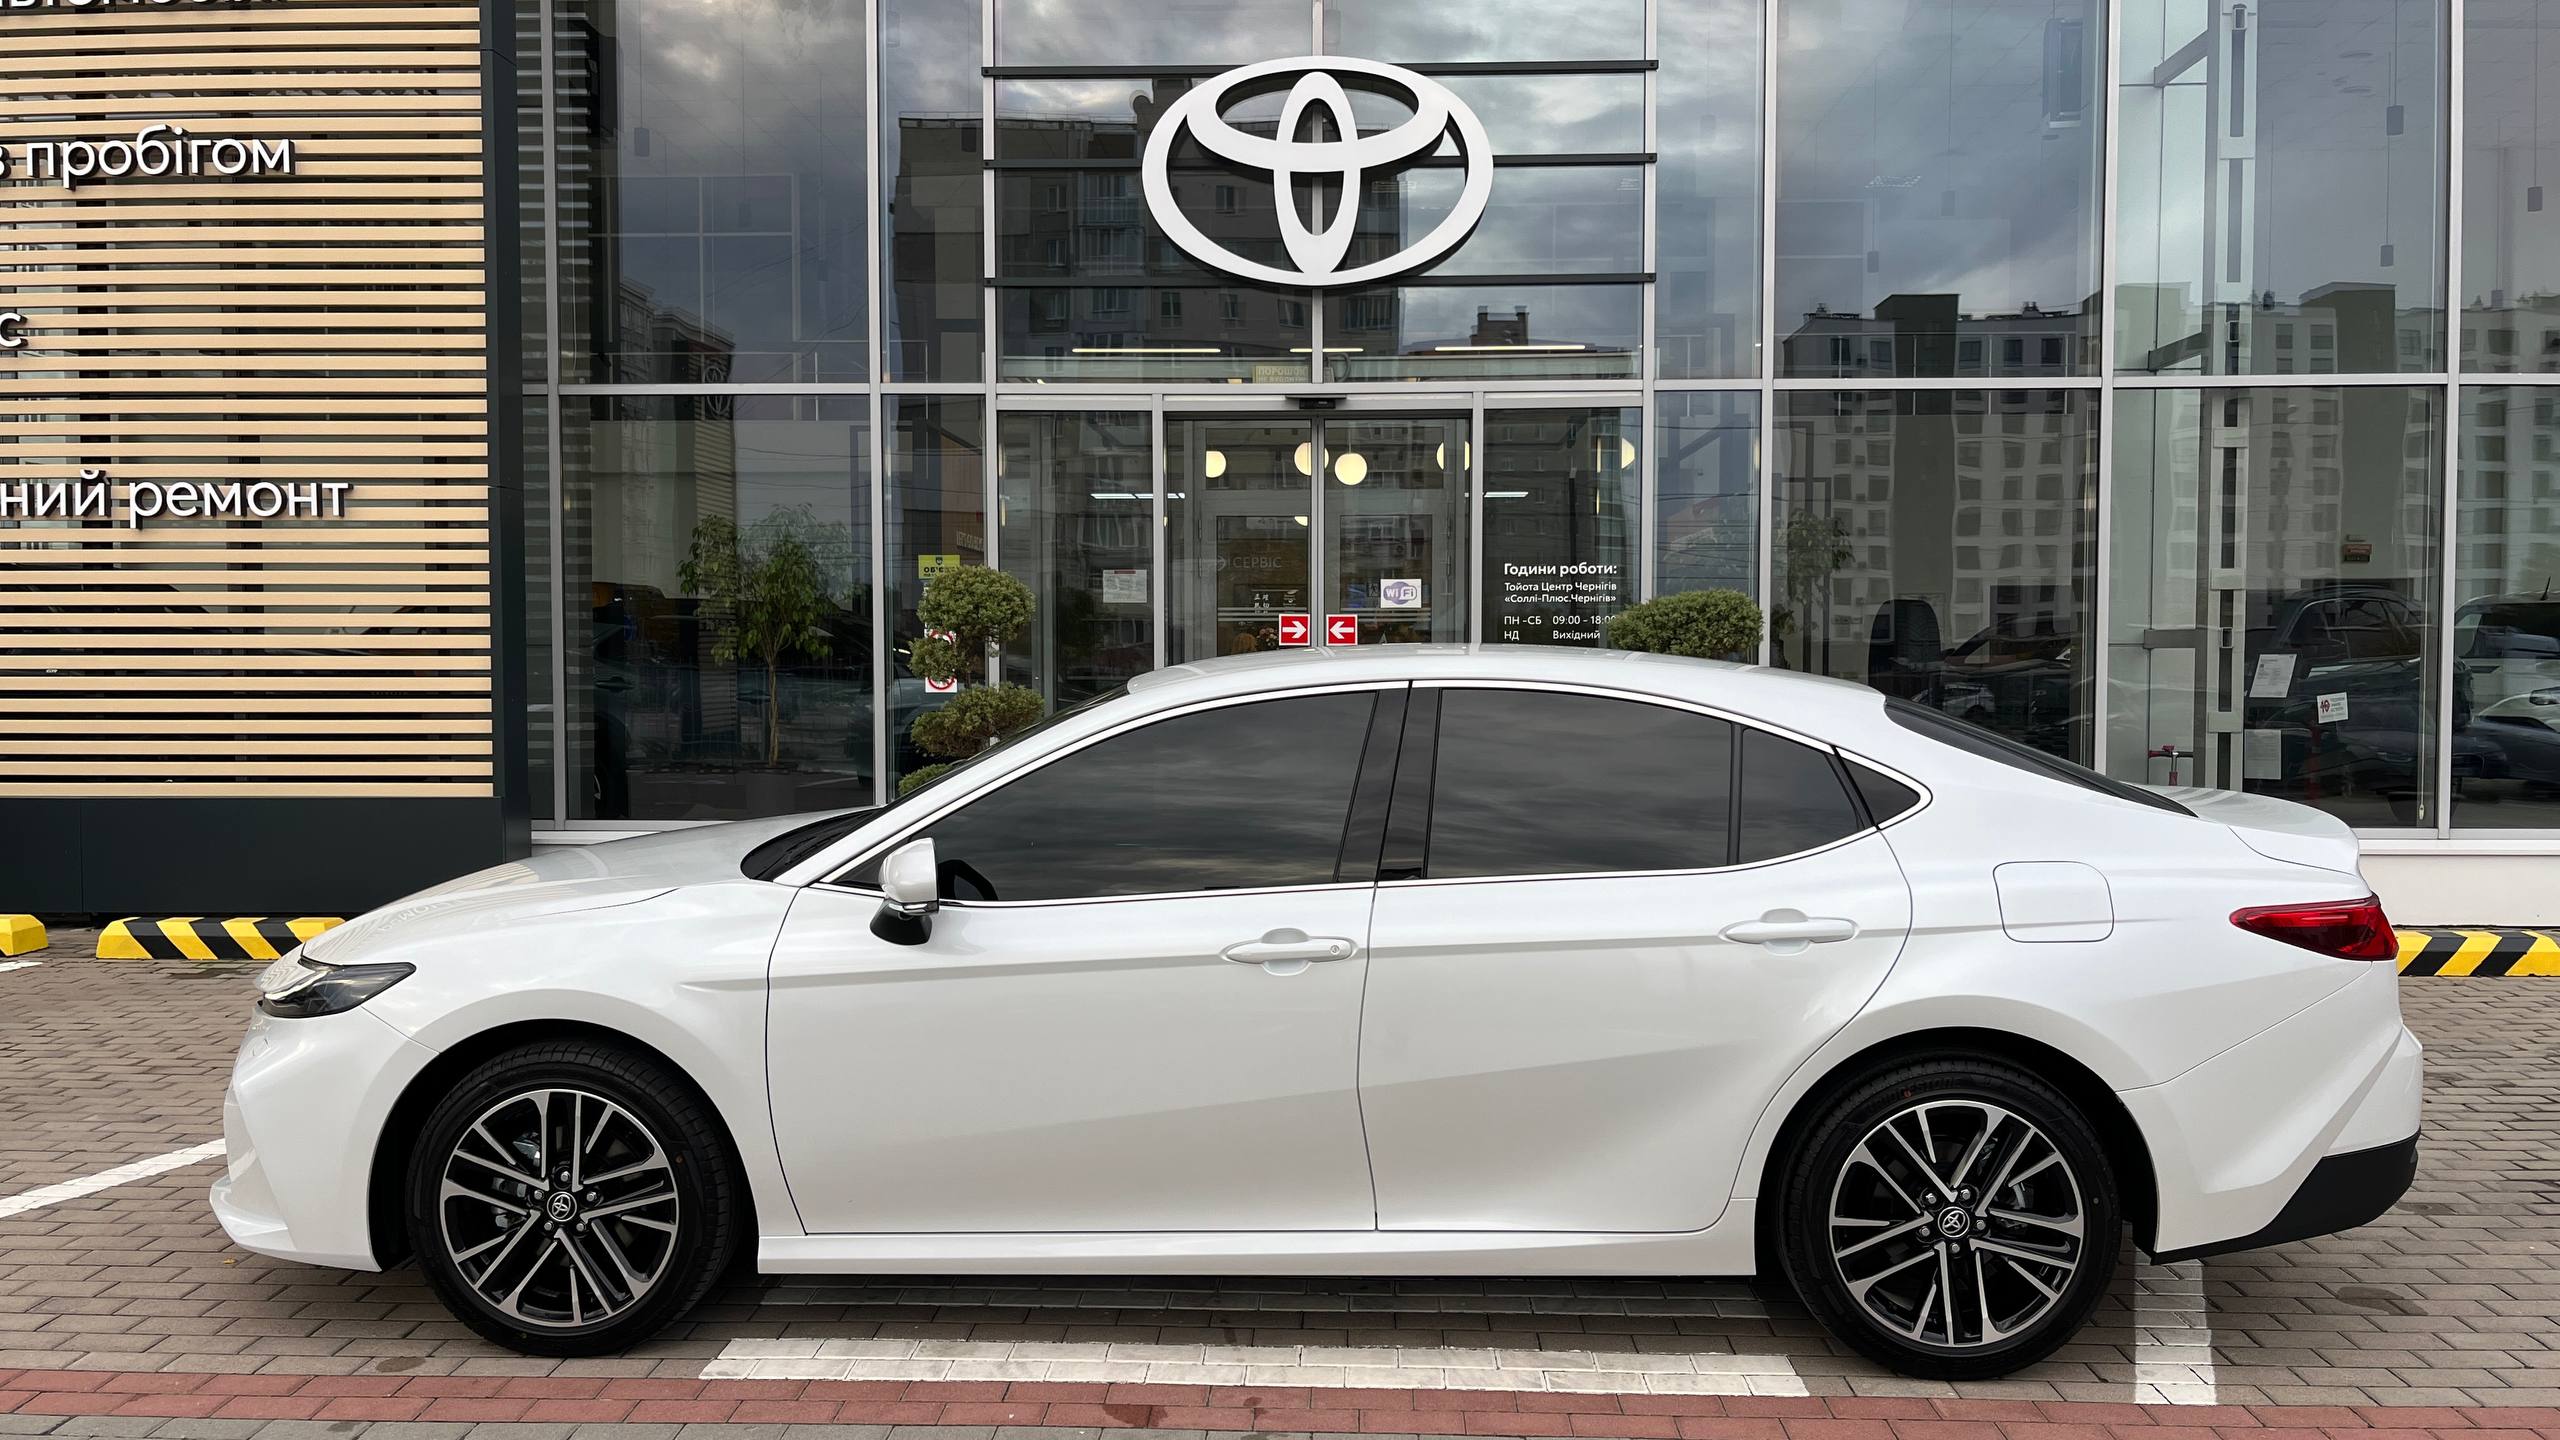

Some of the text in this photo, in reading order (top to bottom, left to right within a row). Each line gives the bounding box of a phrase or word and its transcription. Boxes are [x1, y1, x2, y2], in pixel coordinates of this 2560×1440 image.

[26, 123, 292, 189] пробігом
[129, 481, 350, 529] ремонт
[1504, 562, 1617, 577] Години роботи:
[1504, 582, 1617, 592] Тойота Центр Чернігів
[1504, 616, 1520, 625] ПН
[1552, 616, 1580, 625] 09:00
[1504, 630, 1600, 640] НД Вихідний
